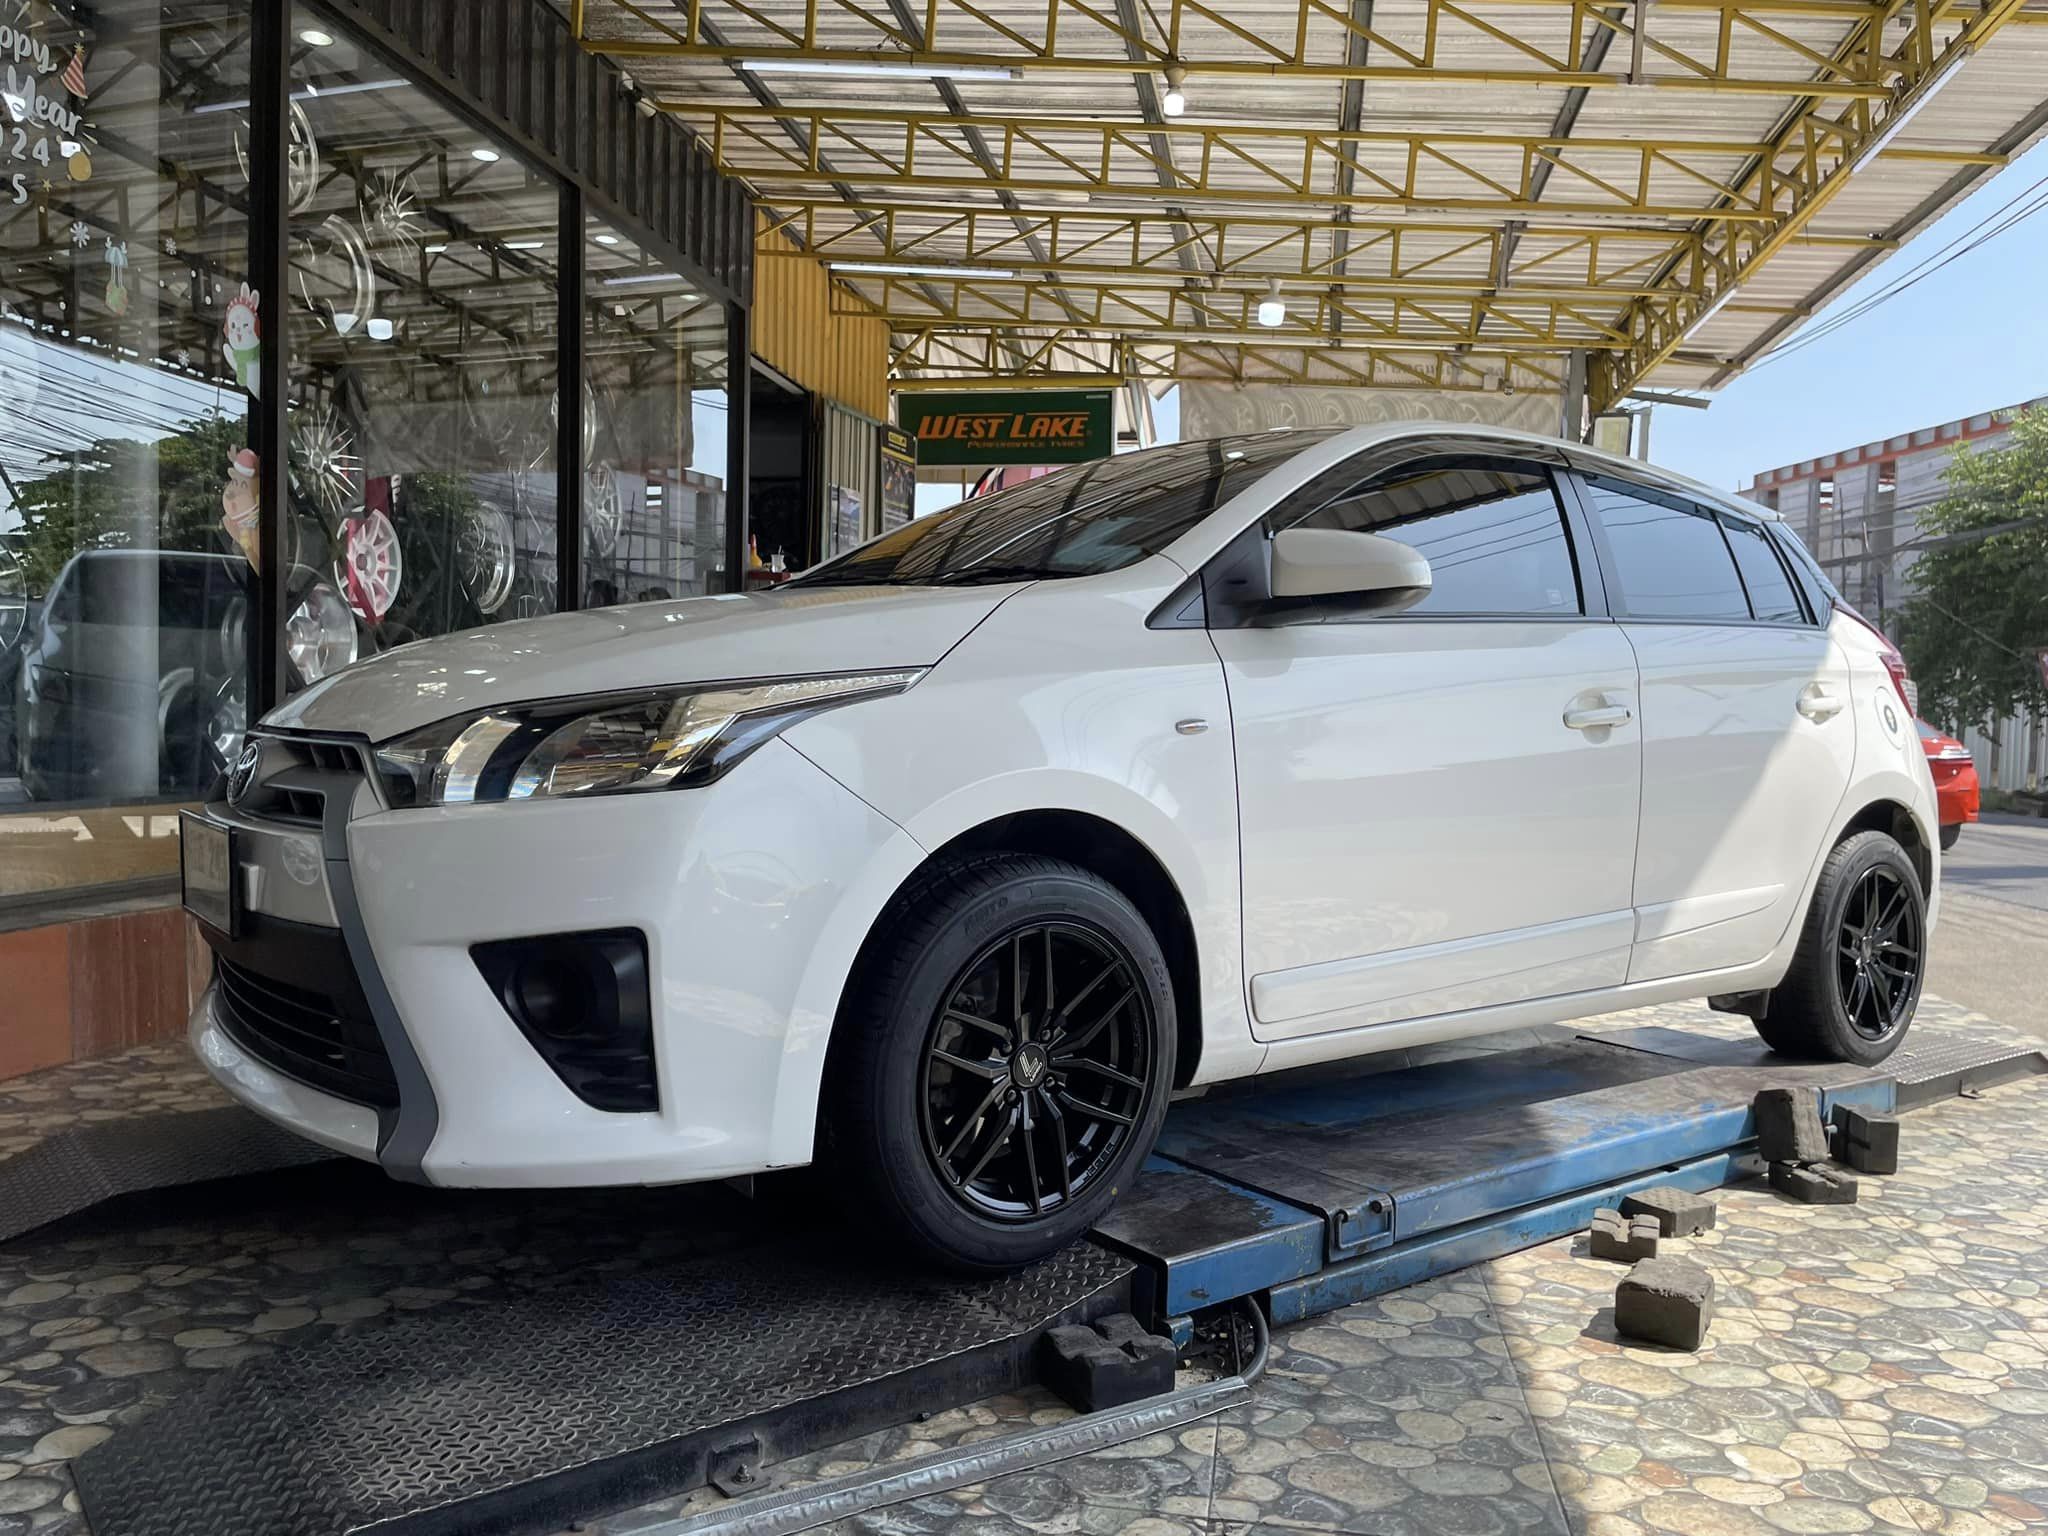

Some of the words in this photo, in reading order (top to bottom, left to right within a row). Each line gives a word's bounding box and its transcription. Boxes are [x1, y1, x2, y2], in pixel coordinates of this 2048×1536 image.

[7, 64, 82, 137] Year
[0, 123, 50, 168] 24
[917, 415, 1005, 439] WEST
[1009, 414, 1089, 438] LAKE
